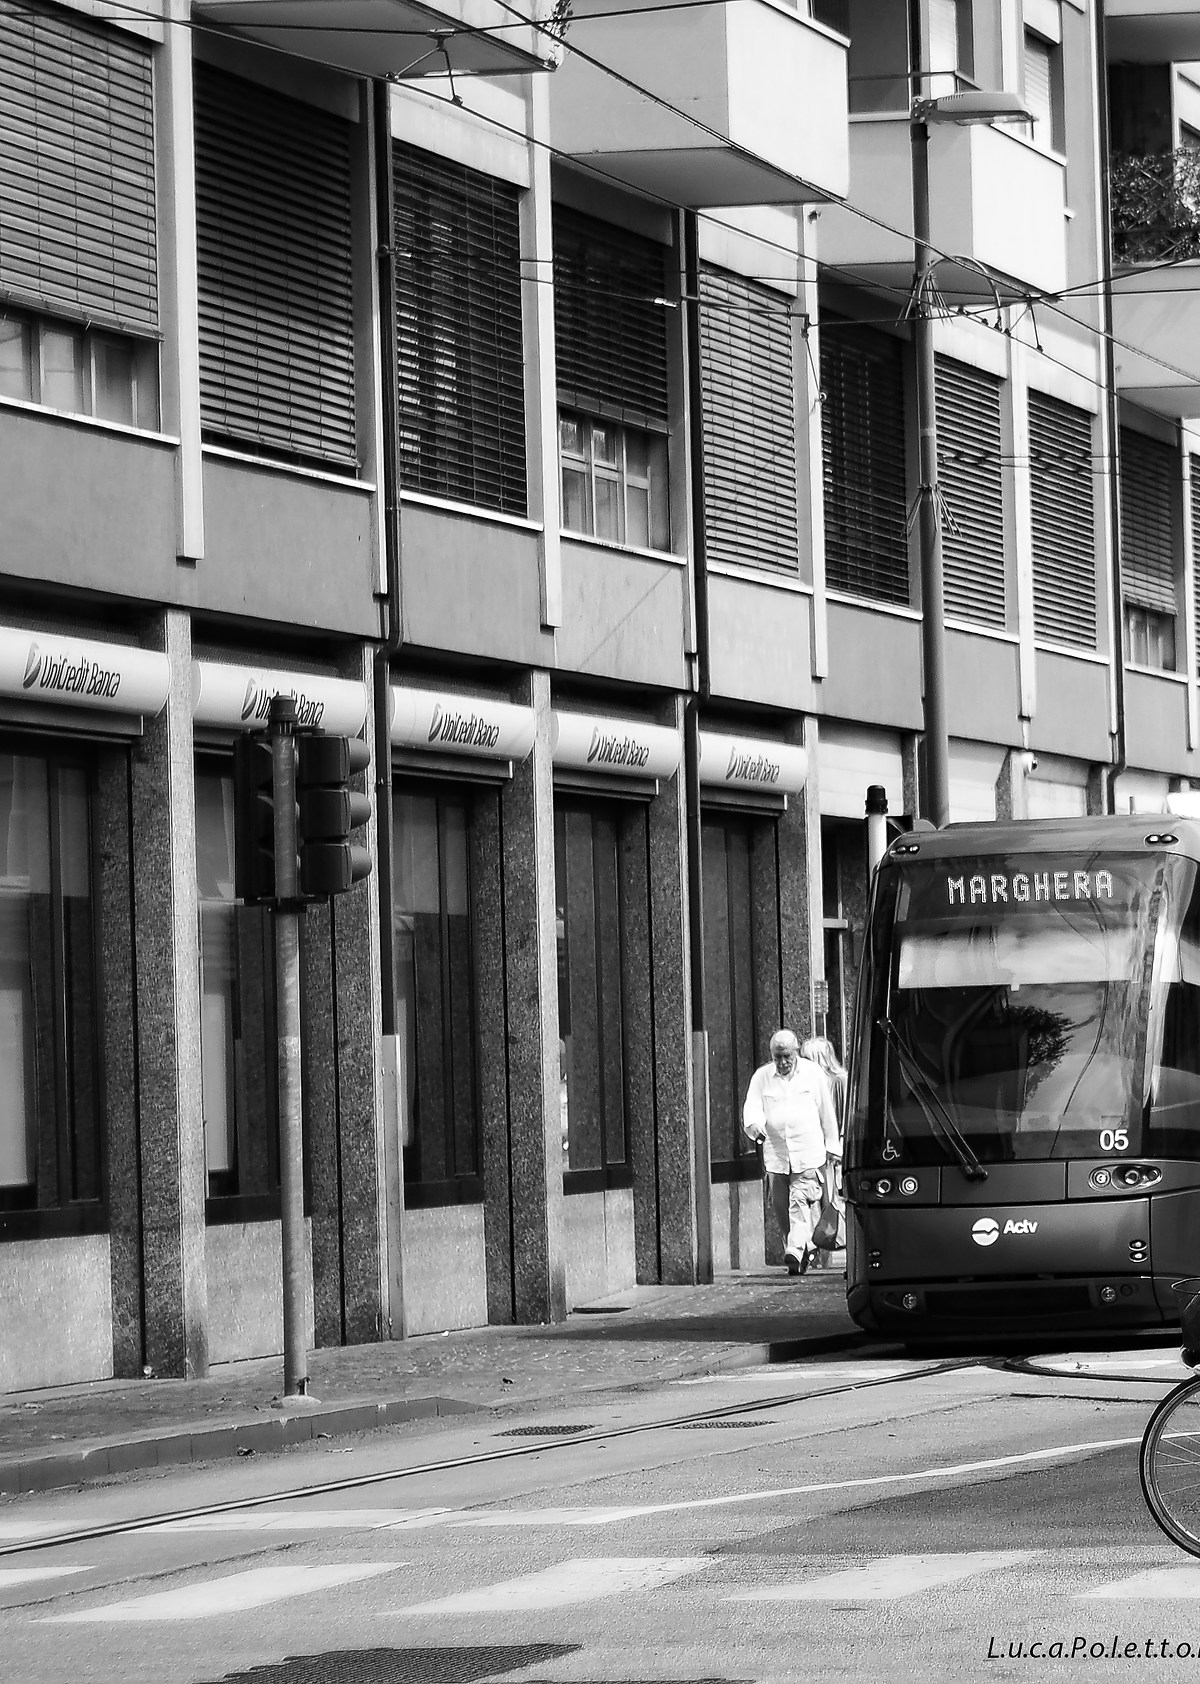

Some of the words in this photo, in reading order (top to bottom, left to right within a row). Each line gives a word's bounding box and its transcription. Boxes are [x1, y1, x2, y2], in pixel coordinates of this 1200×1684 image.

[39, 655, 89, 693] UniCredit
[86, 663, 121, 698] Banca
[297, 694, 325, 725] Banca
[440, 712, 477, 744] UniCredit
[473, 718, 500, 748] Banca
[627, 740, 650, 768] Banca
[947, 870, 1113, 905] MARGHERA
[1099, 1129, 1129, 1151] 05
[1003, 1218, 1038, 1236] Actv
